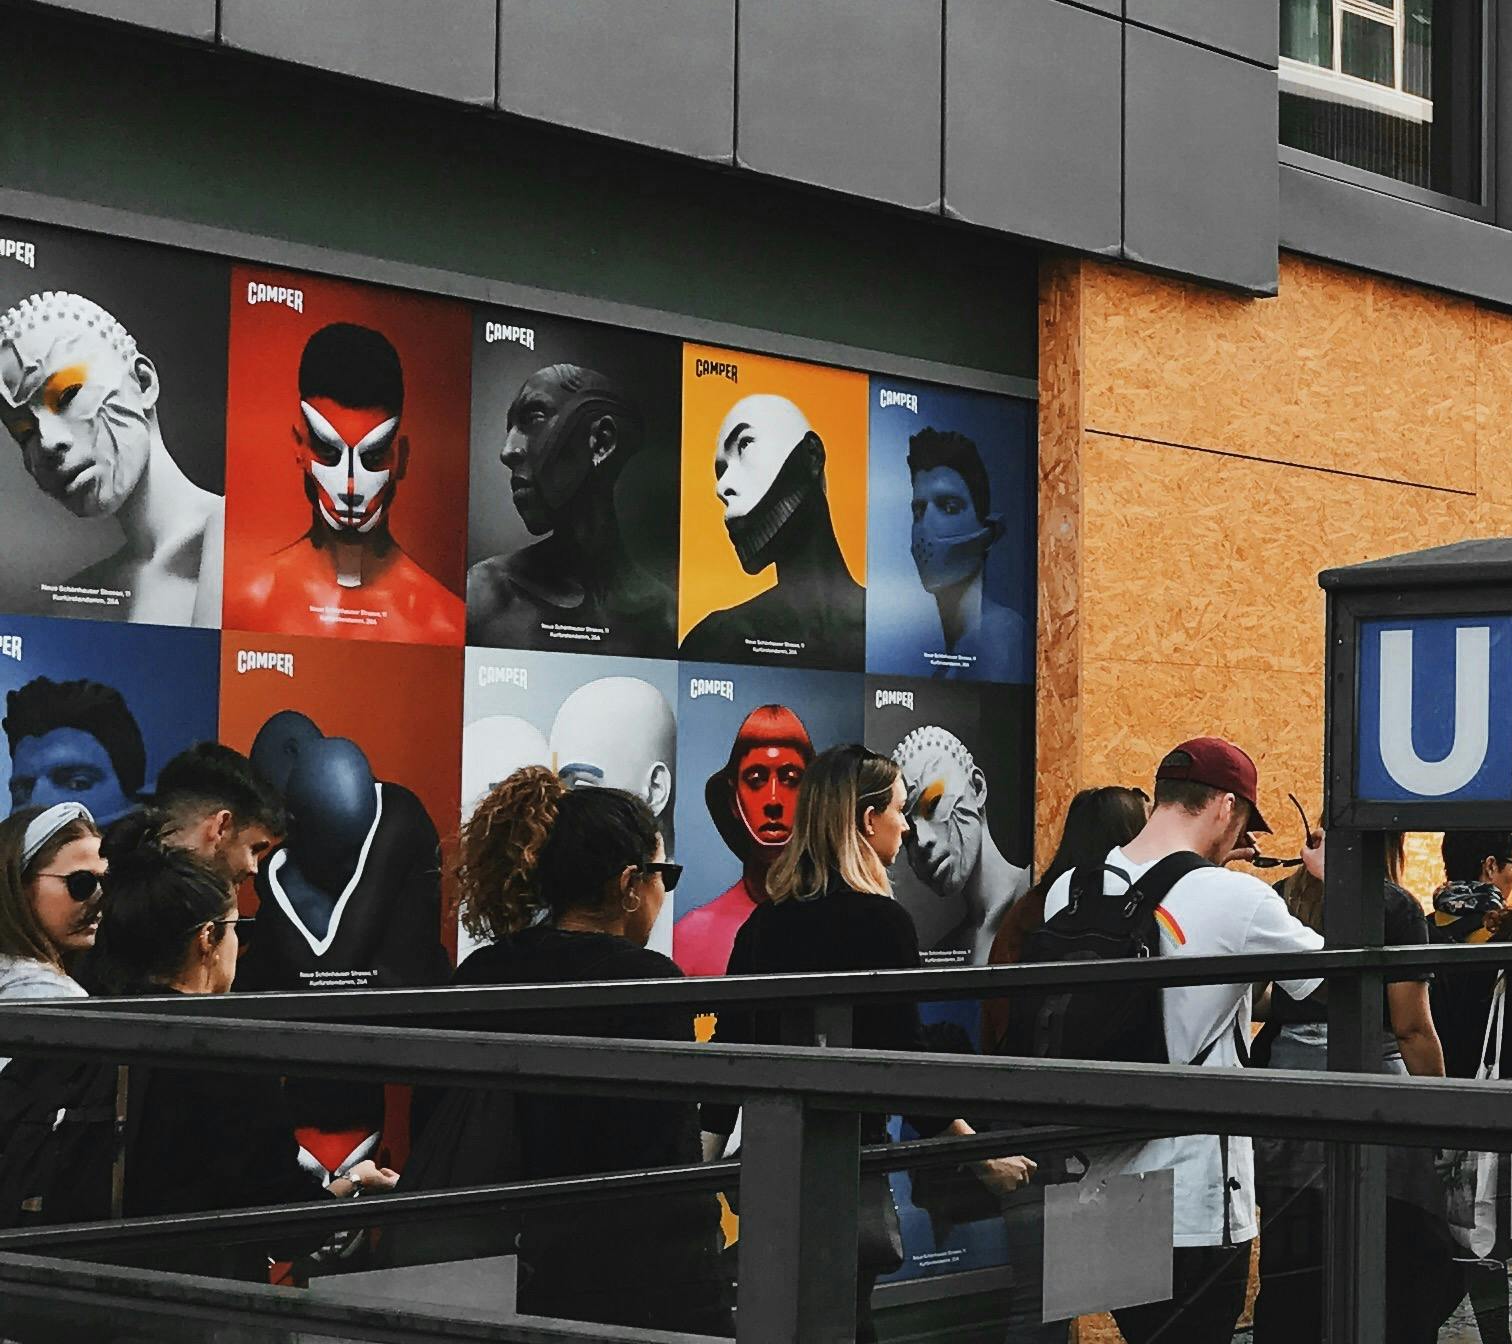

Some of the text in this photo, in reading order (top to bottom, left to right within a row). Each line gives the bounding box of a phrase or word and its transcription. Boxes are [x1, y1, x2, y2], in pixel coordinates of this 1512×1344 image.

[248, 282, 303, 313] CAMPER
[486, 322, 534, 350] CAMPER
[695, 359, 738, 383] CAMPER
[880, 389, 917, 414] CAMPER
[238, 651, 293, 677] CAMPER
[479, 666, 527, 689] CAMPER
[691, 679, 733, 701] CAMPER
[876, 690, 913, 710] CAMPER
[1380, 627, 1489, 795] U
